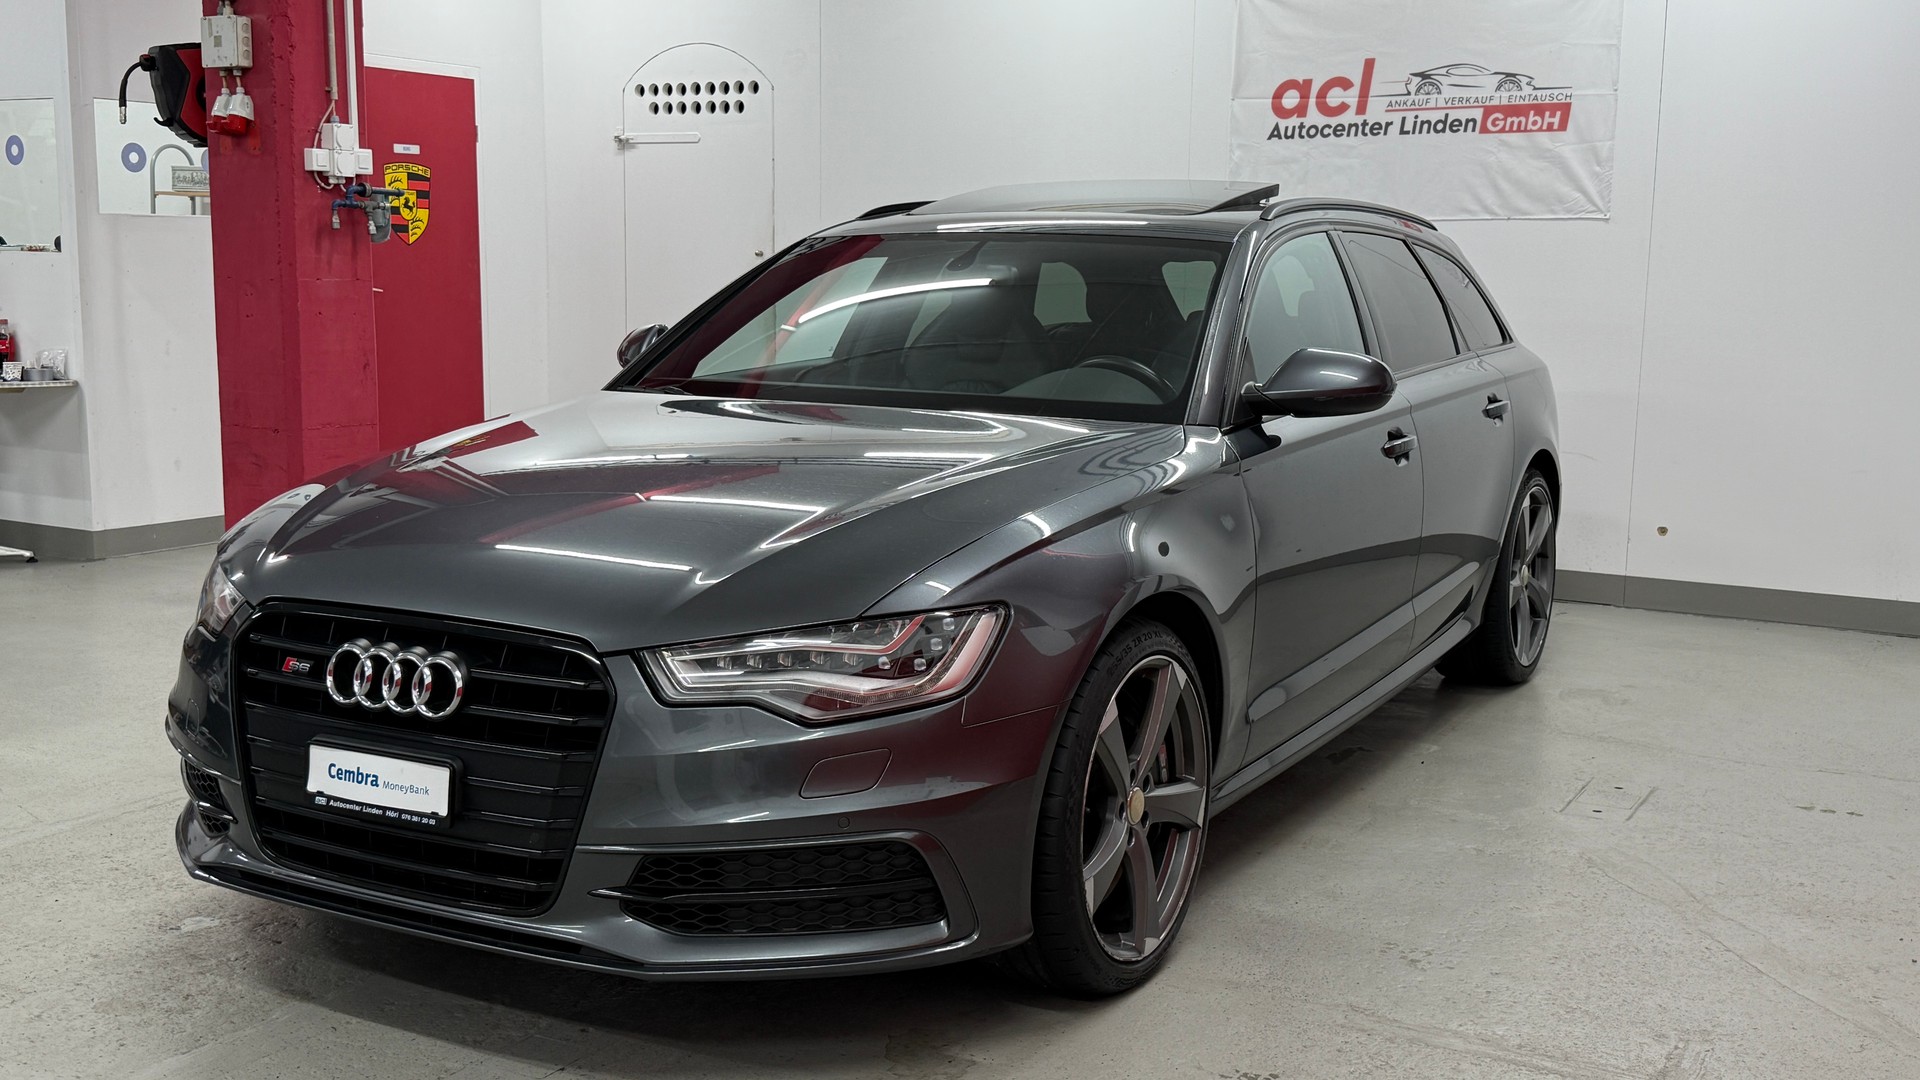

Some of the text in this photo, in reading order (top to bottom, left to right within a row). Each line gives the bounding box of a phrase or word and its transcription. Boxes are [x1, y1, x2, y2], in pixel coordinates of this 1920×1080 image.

[1271, 57, 1376, 120] acl
[1386, 98, 1431, 109] ANKAUF
[1444, 95, 1495, 106] VERKAUF
[1507, 92, 1573, 104] EINTAUSCH
[1267, 110, 1561, 141] Autocenter Linden GmbH
[385, 164, 429, 176] PORSCHE
[1143, 631, 1153, 641] 20
[328, 762, 430, 796] Cembra MoneyBank
[329, 799, 361, 811] Autocenter
[363, 805, 383, 815] Linden
